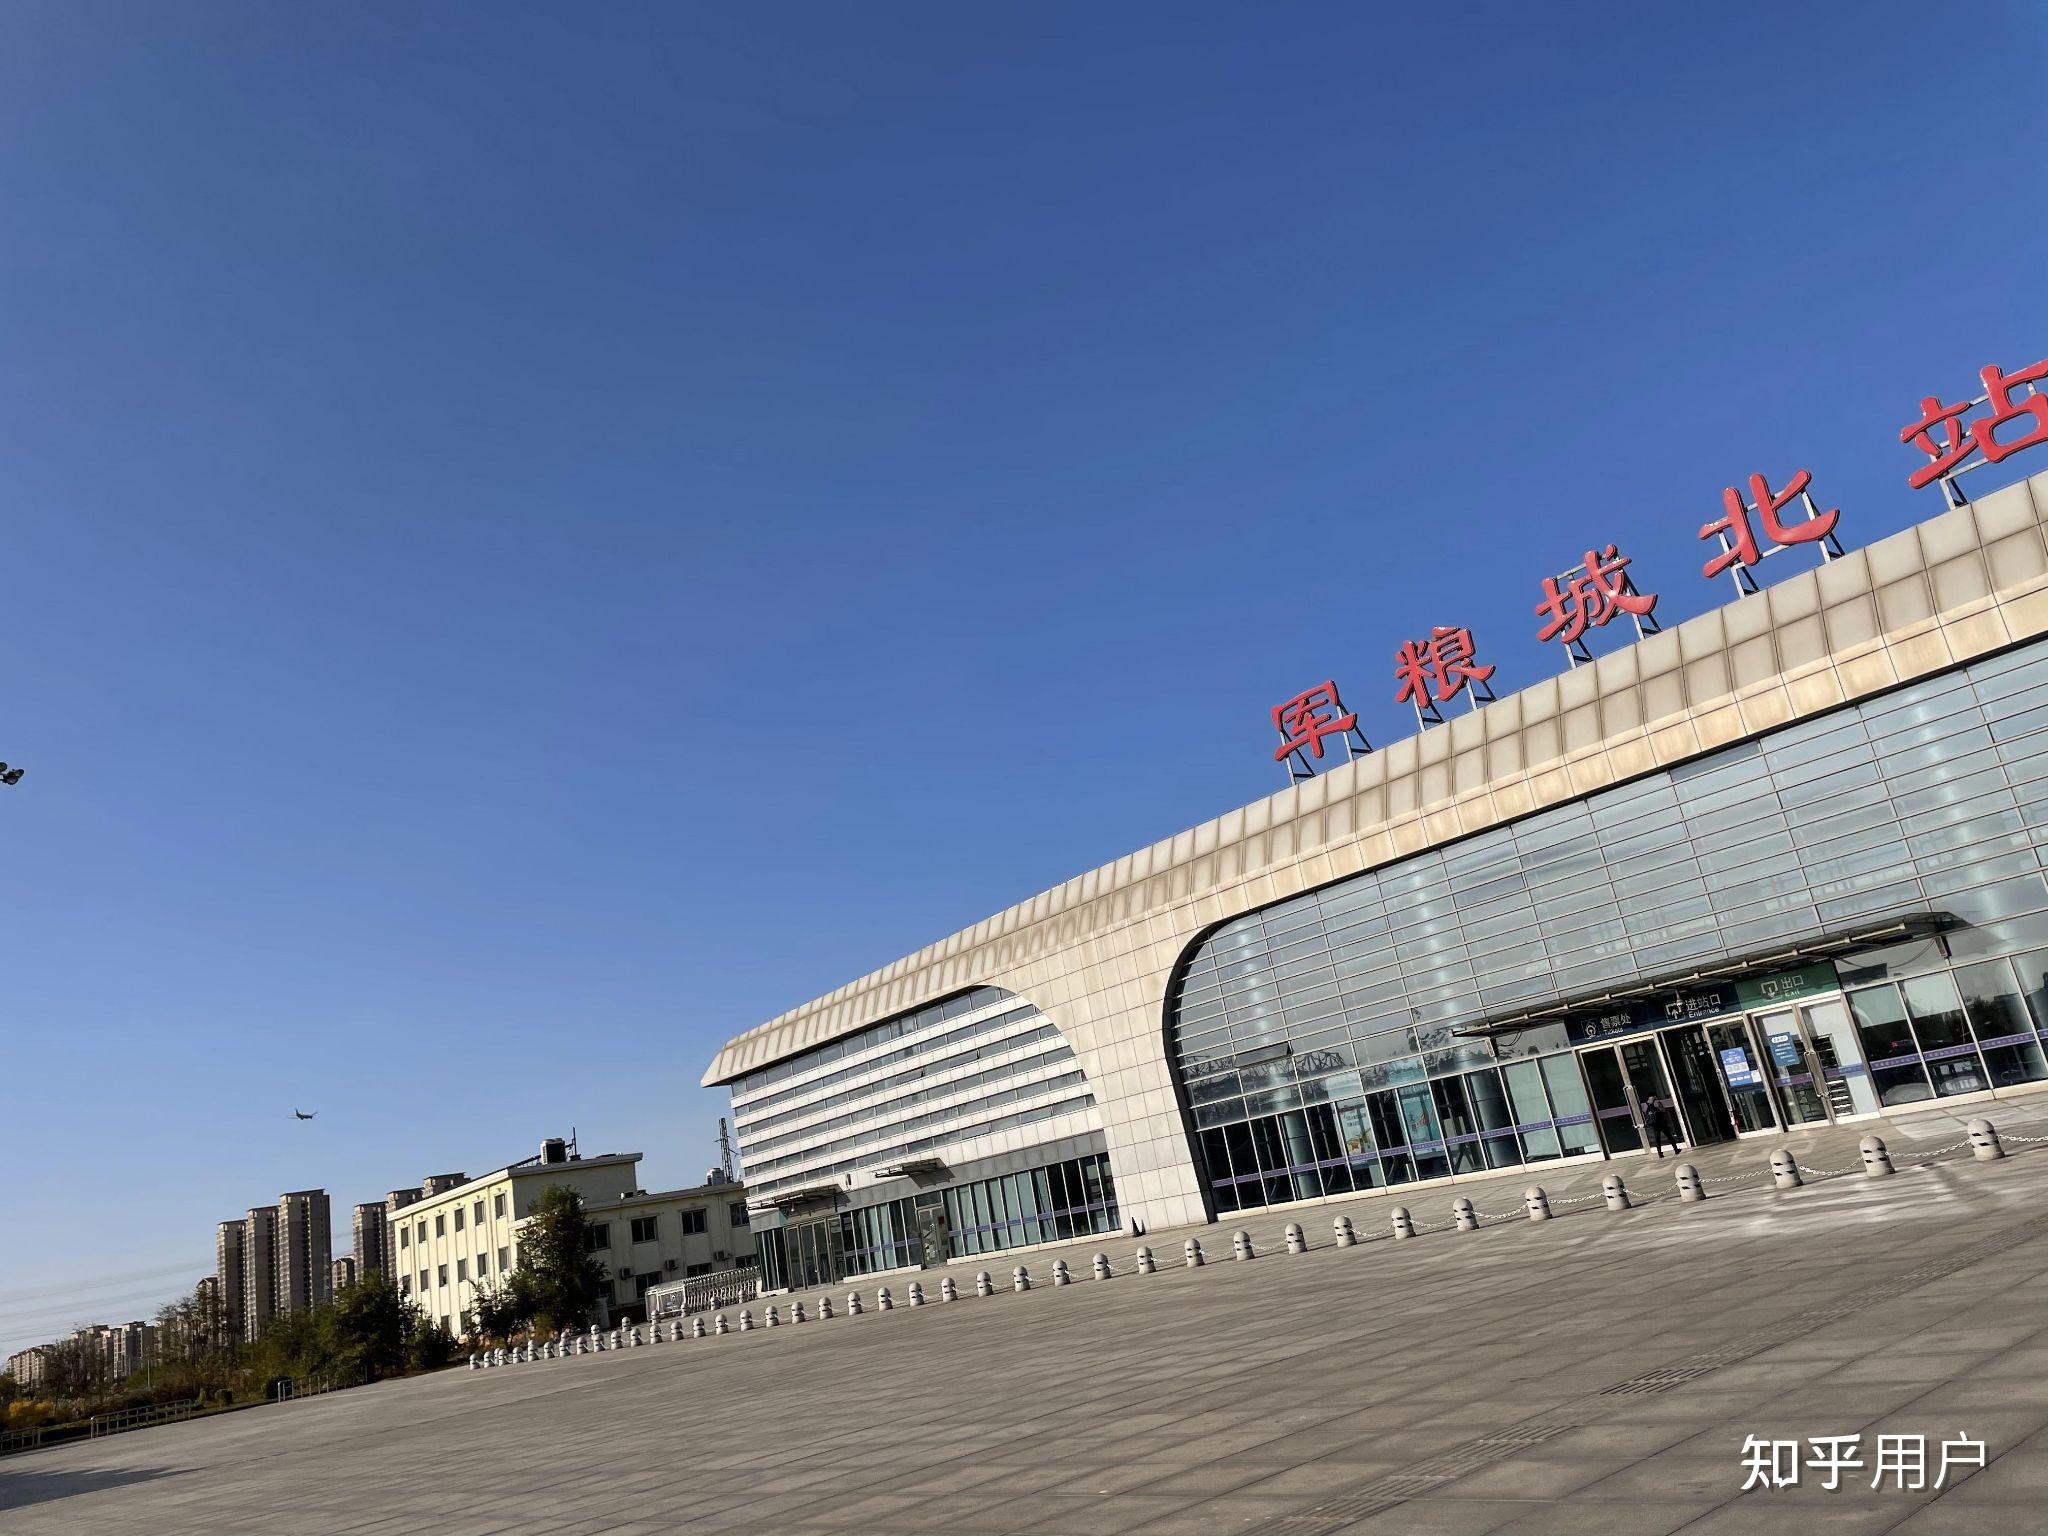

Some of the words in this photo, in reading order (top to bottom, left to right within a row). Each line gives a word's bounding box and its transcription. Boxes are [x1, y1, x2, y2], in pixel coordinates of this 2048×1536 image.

[1272, 359, 2048, 762] 军粮城北站
[1781, 974, 1804, 990] 出口
[1685, 993, 1721, 1011] 进站口
[1600, 1012, 1631, 1029] 售票处
[1688, 1007, 1720, 1019] Entrance
